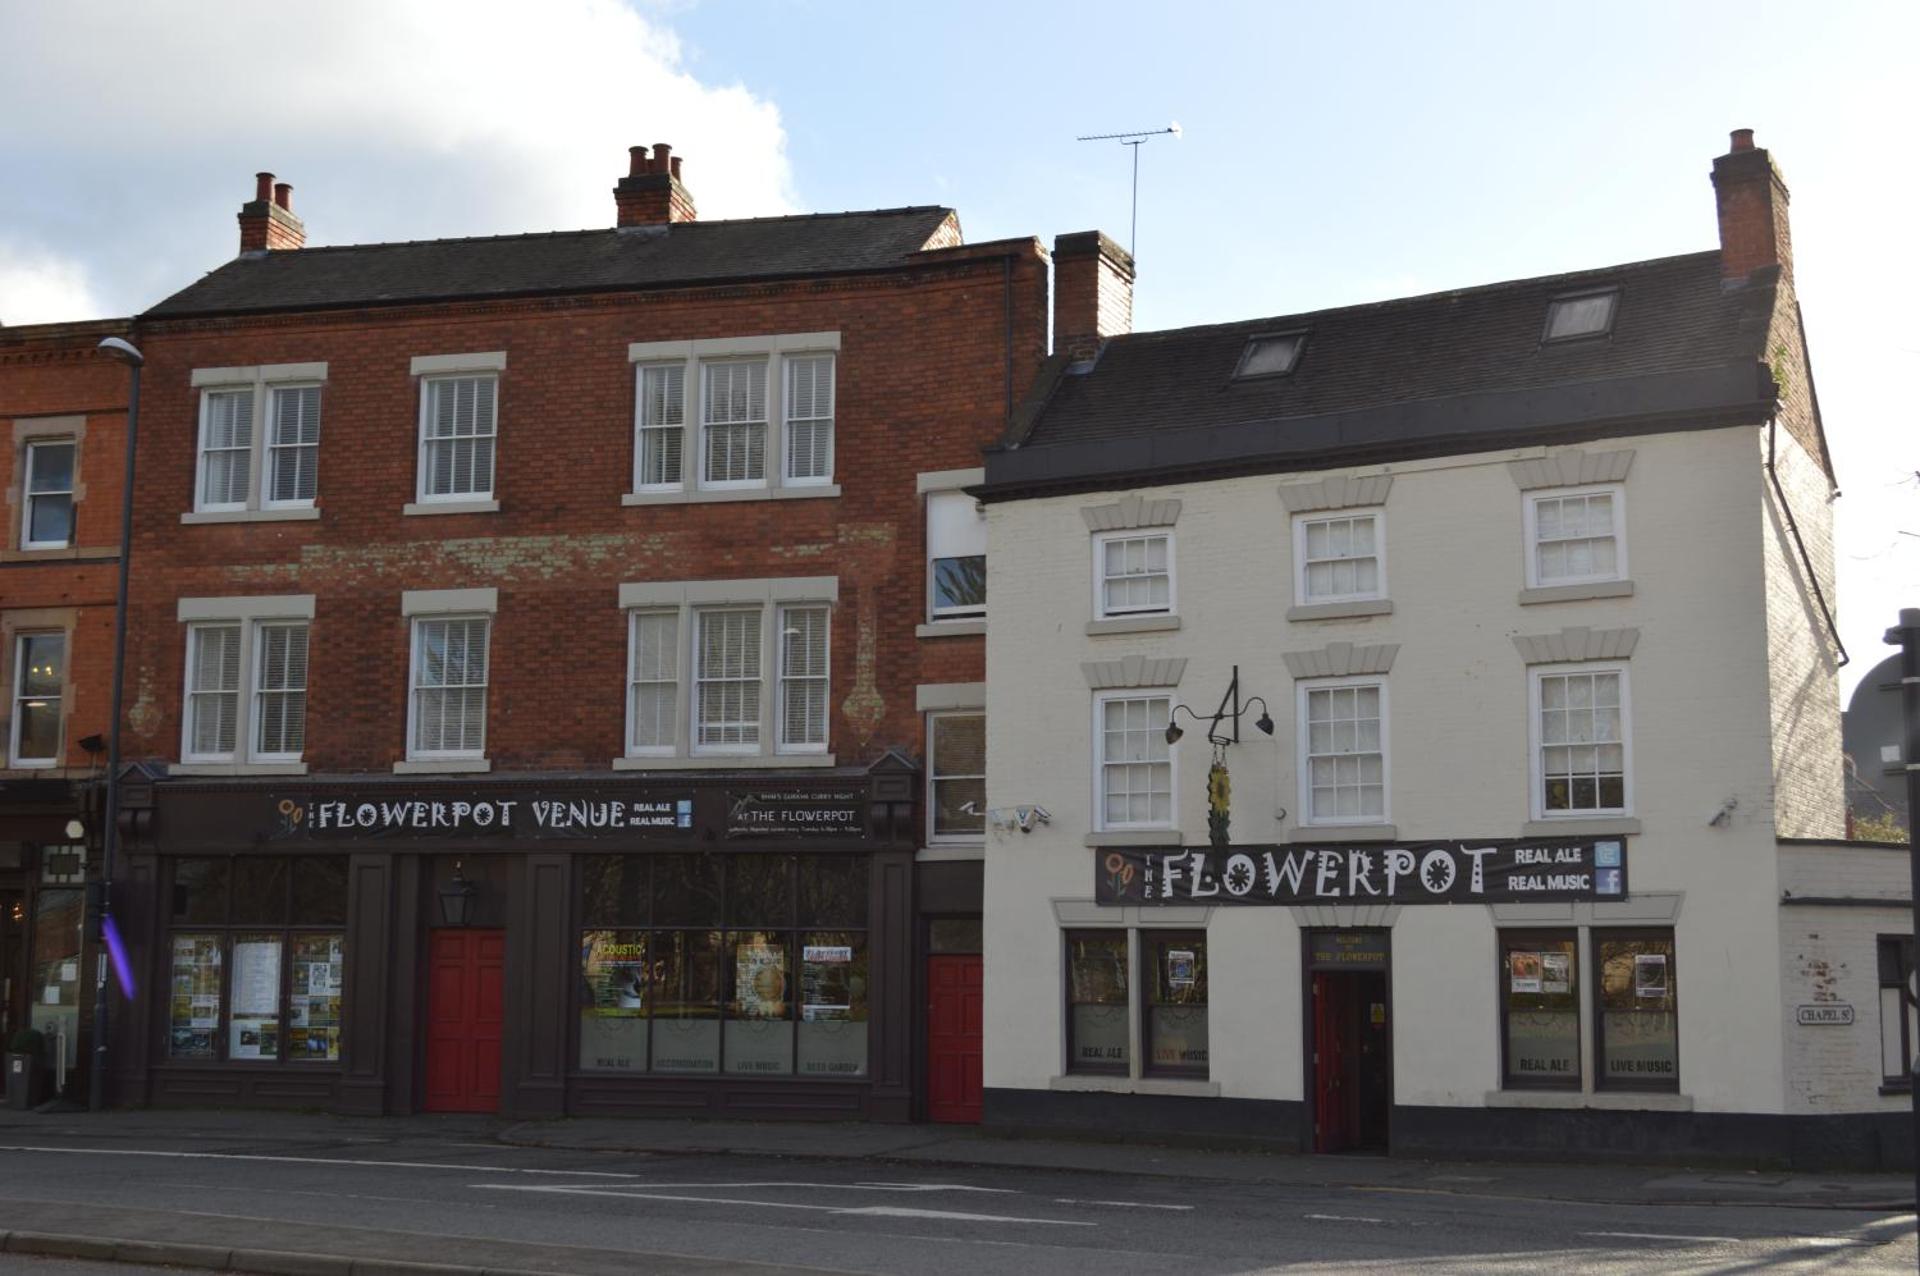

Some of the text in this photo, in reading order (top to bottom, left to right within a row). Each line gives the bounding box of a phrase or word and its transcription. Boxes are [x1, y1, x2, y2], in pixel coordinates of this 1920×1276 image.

[834, 792, 854, 800] NIGHT
[319, 799, 518, 828] FLOWERPOT
[531, 799, 626, 828] VENUE
[633, 802, 672, 813] REAL ALE
[630, 816, 675, 826] REAL MUSIC
[750, 810, 776, 822] THE
[781, 810, 856, 822] FLOWERPOT
[1514, 847, 1582, 864] REAL ALE
[1145, 844, 1498, 898] THE FLOWERPOT
[1507, 874, 1590, 891] REAL MUSIC
[597, 943, 642, 956] ACOUSTIC
[1801, 1009, 1840, 1021] CHAPEL
[1082, 1047, 1122, 1058] REAL ALE
[1520, 1059, 1570, 1072] REAL ALE
[1610, 1060, 1672, 1074] LIVE MUSIC
